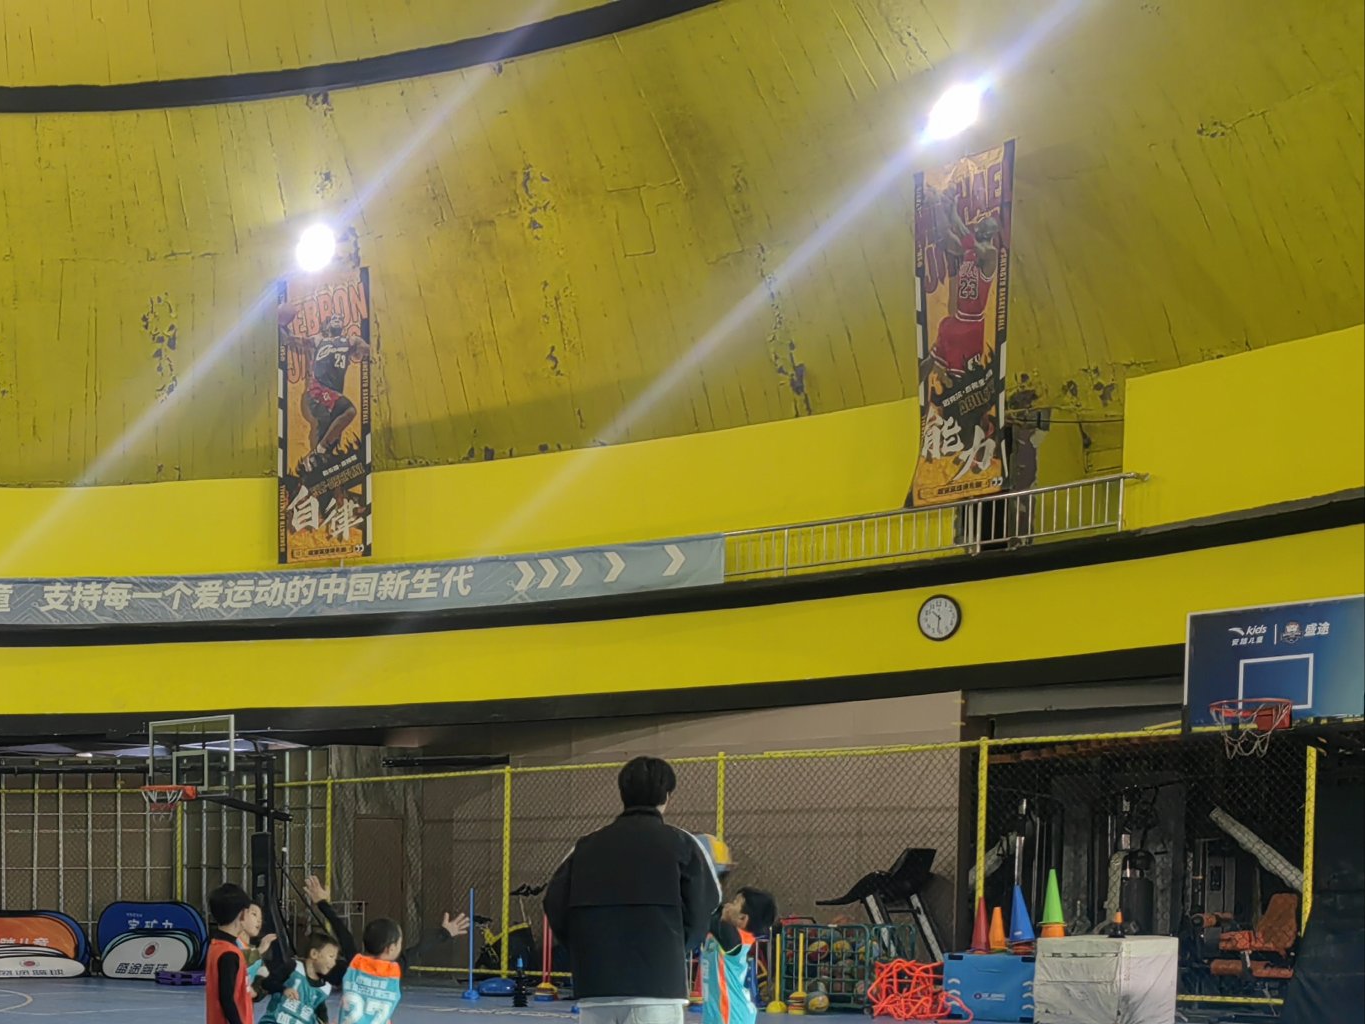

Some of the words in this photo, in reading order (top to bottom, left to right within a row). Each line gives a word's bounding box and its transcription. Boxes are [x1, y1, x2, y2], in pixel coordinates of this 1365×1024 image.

[959, 277, 978, 299] 23
[334, 353, 347, 369] 23
[922, 405, 996, 481] 能力
[286, 485, 364, 541] 自律
[42, 565, 474, 613] 支持每一个爱运动的中国新生代
[1246, 624, 1267, 636] kids
[1303, 621, 1330, 637] 盛途
